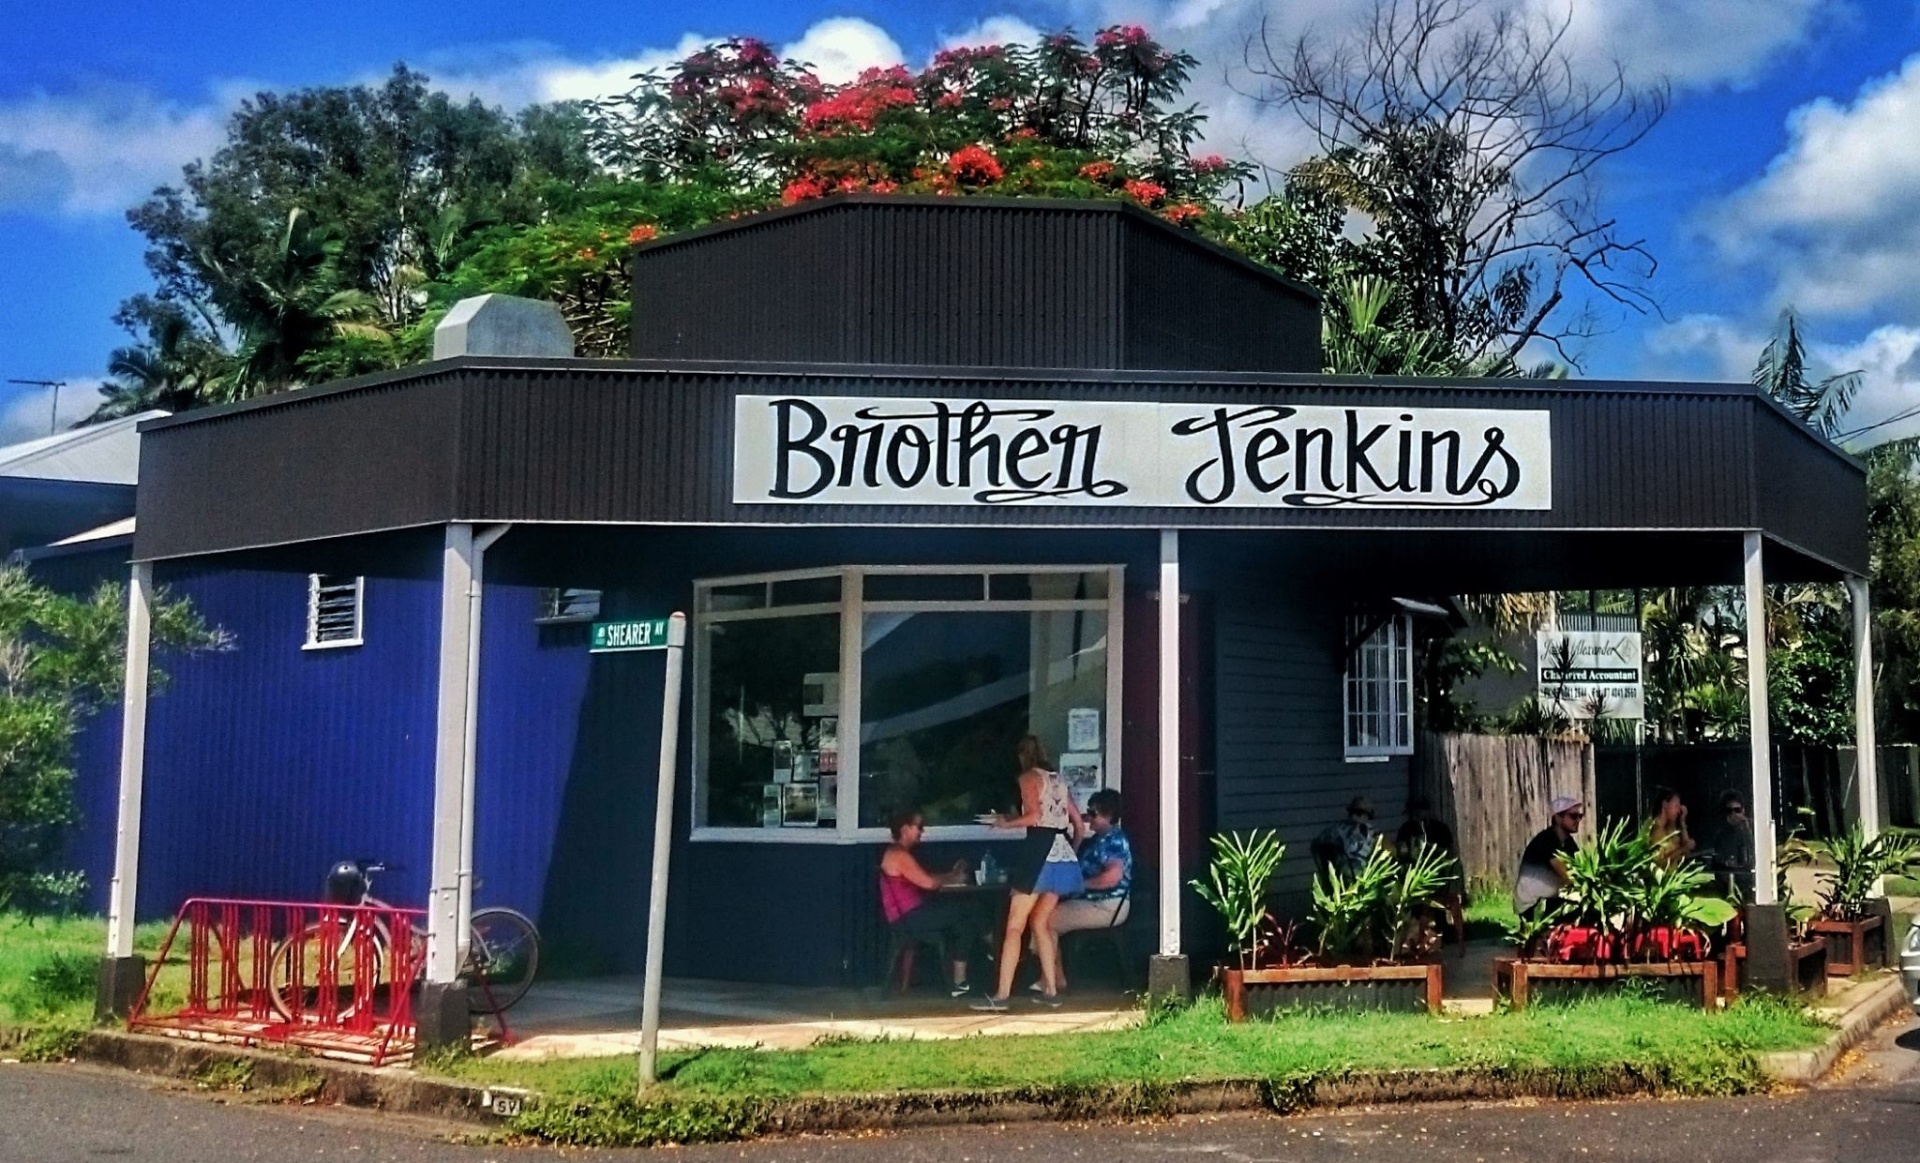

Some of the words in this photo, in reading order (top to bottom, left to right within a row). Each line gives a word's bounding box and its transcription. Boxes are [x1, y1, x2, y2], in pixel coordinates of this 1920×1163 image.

[768, 398, 1129, 504] Brother
[1171, 405, 1521, 507] Jenkins
[607, 623, 651, 646] SHEARER
[1589, 670, 1636, 680] Accountant
[498, 1100, 516, 1113] SV
